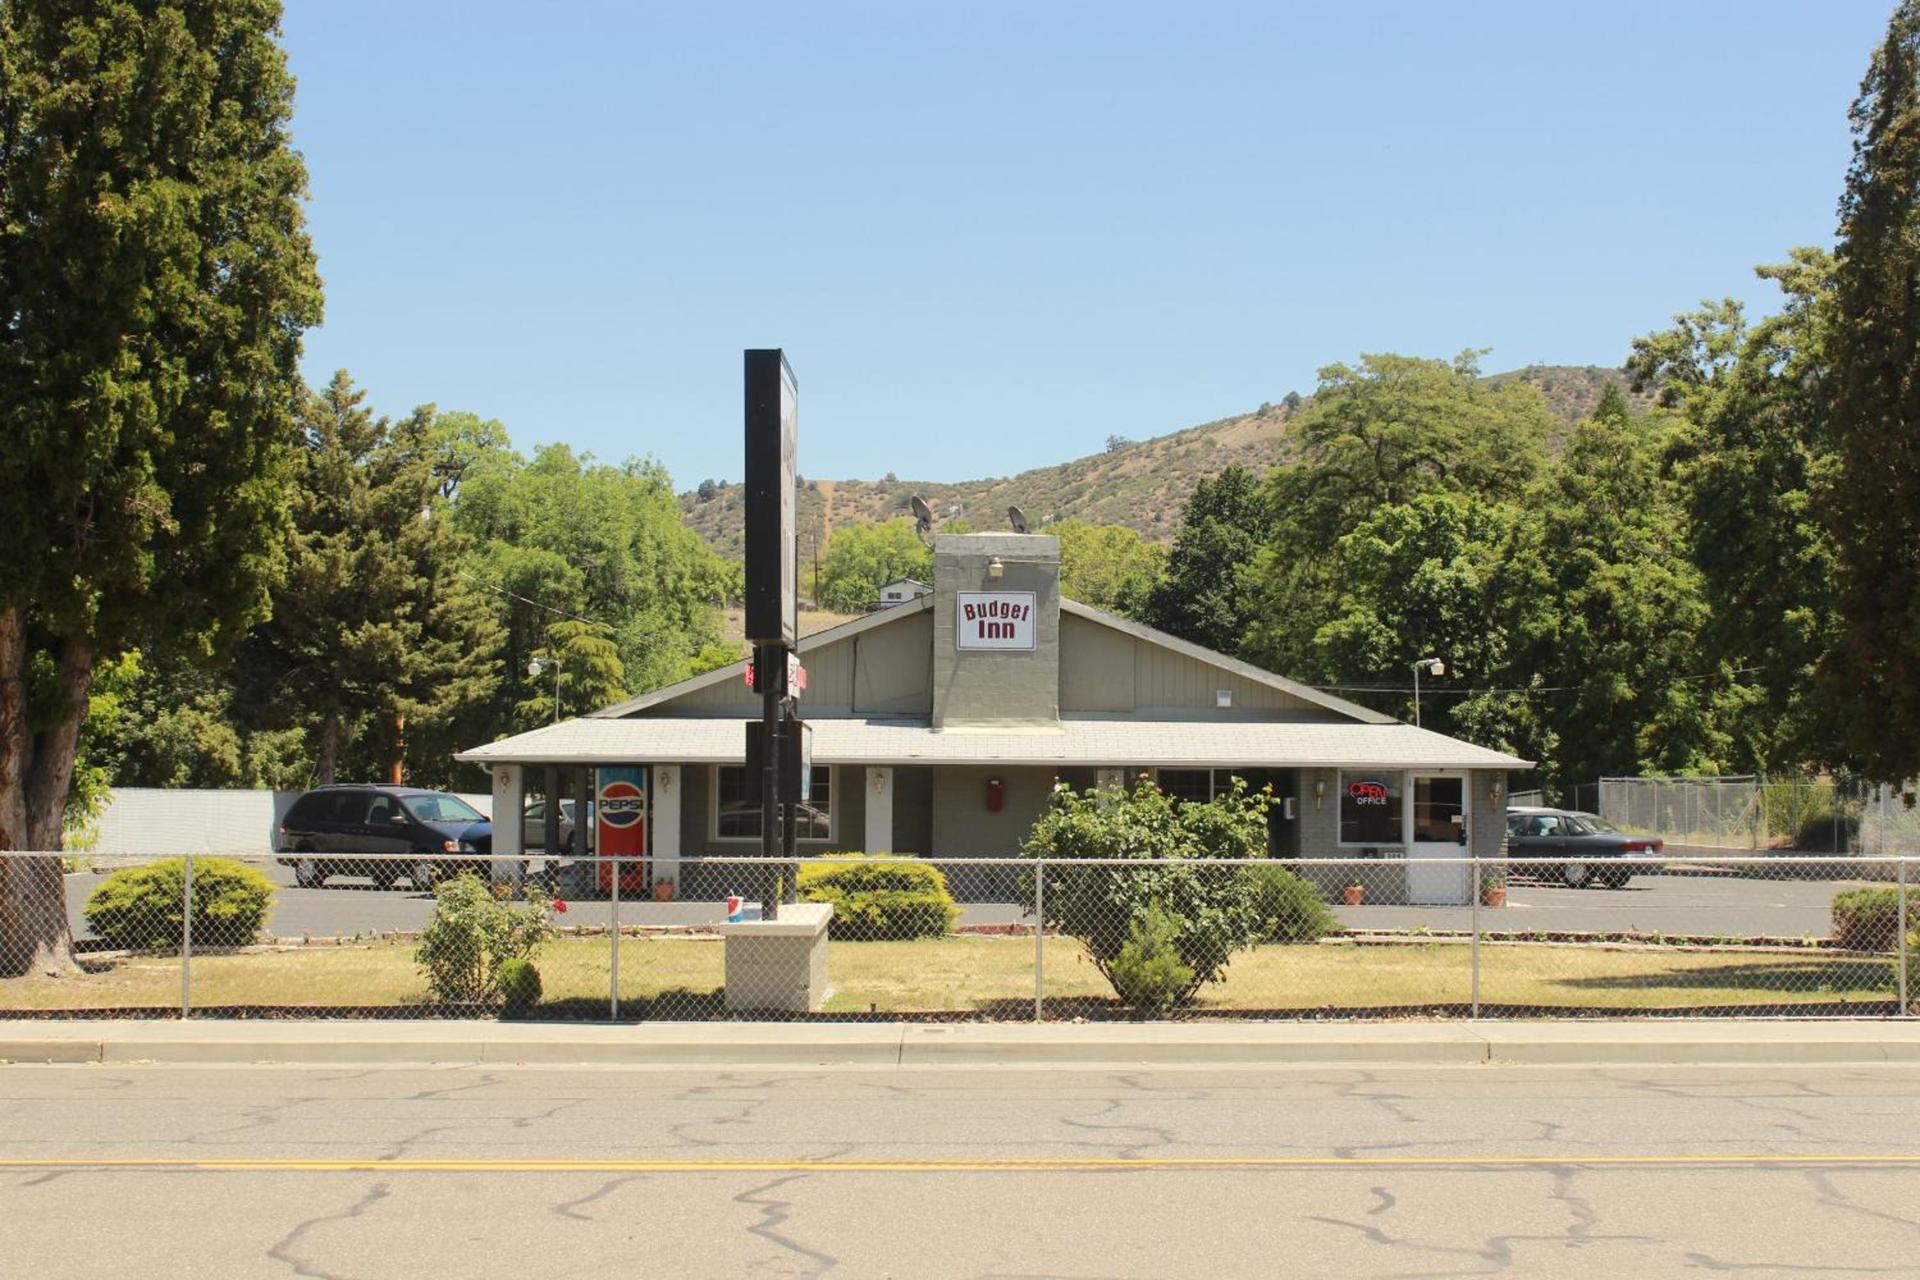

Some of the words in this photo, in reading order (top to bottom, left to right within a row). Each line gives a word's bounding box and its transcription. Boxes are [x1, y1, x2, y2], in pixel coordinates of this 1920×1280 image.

[964, 600, 1030, 622] Budget
[979, 619, 1015, 639] Inn
[1350, 783, 1388, 798] OPEN
[599, 799, 643, 810] PEPSI
[1356, 797, 1387, 805] OFFICE
